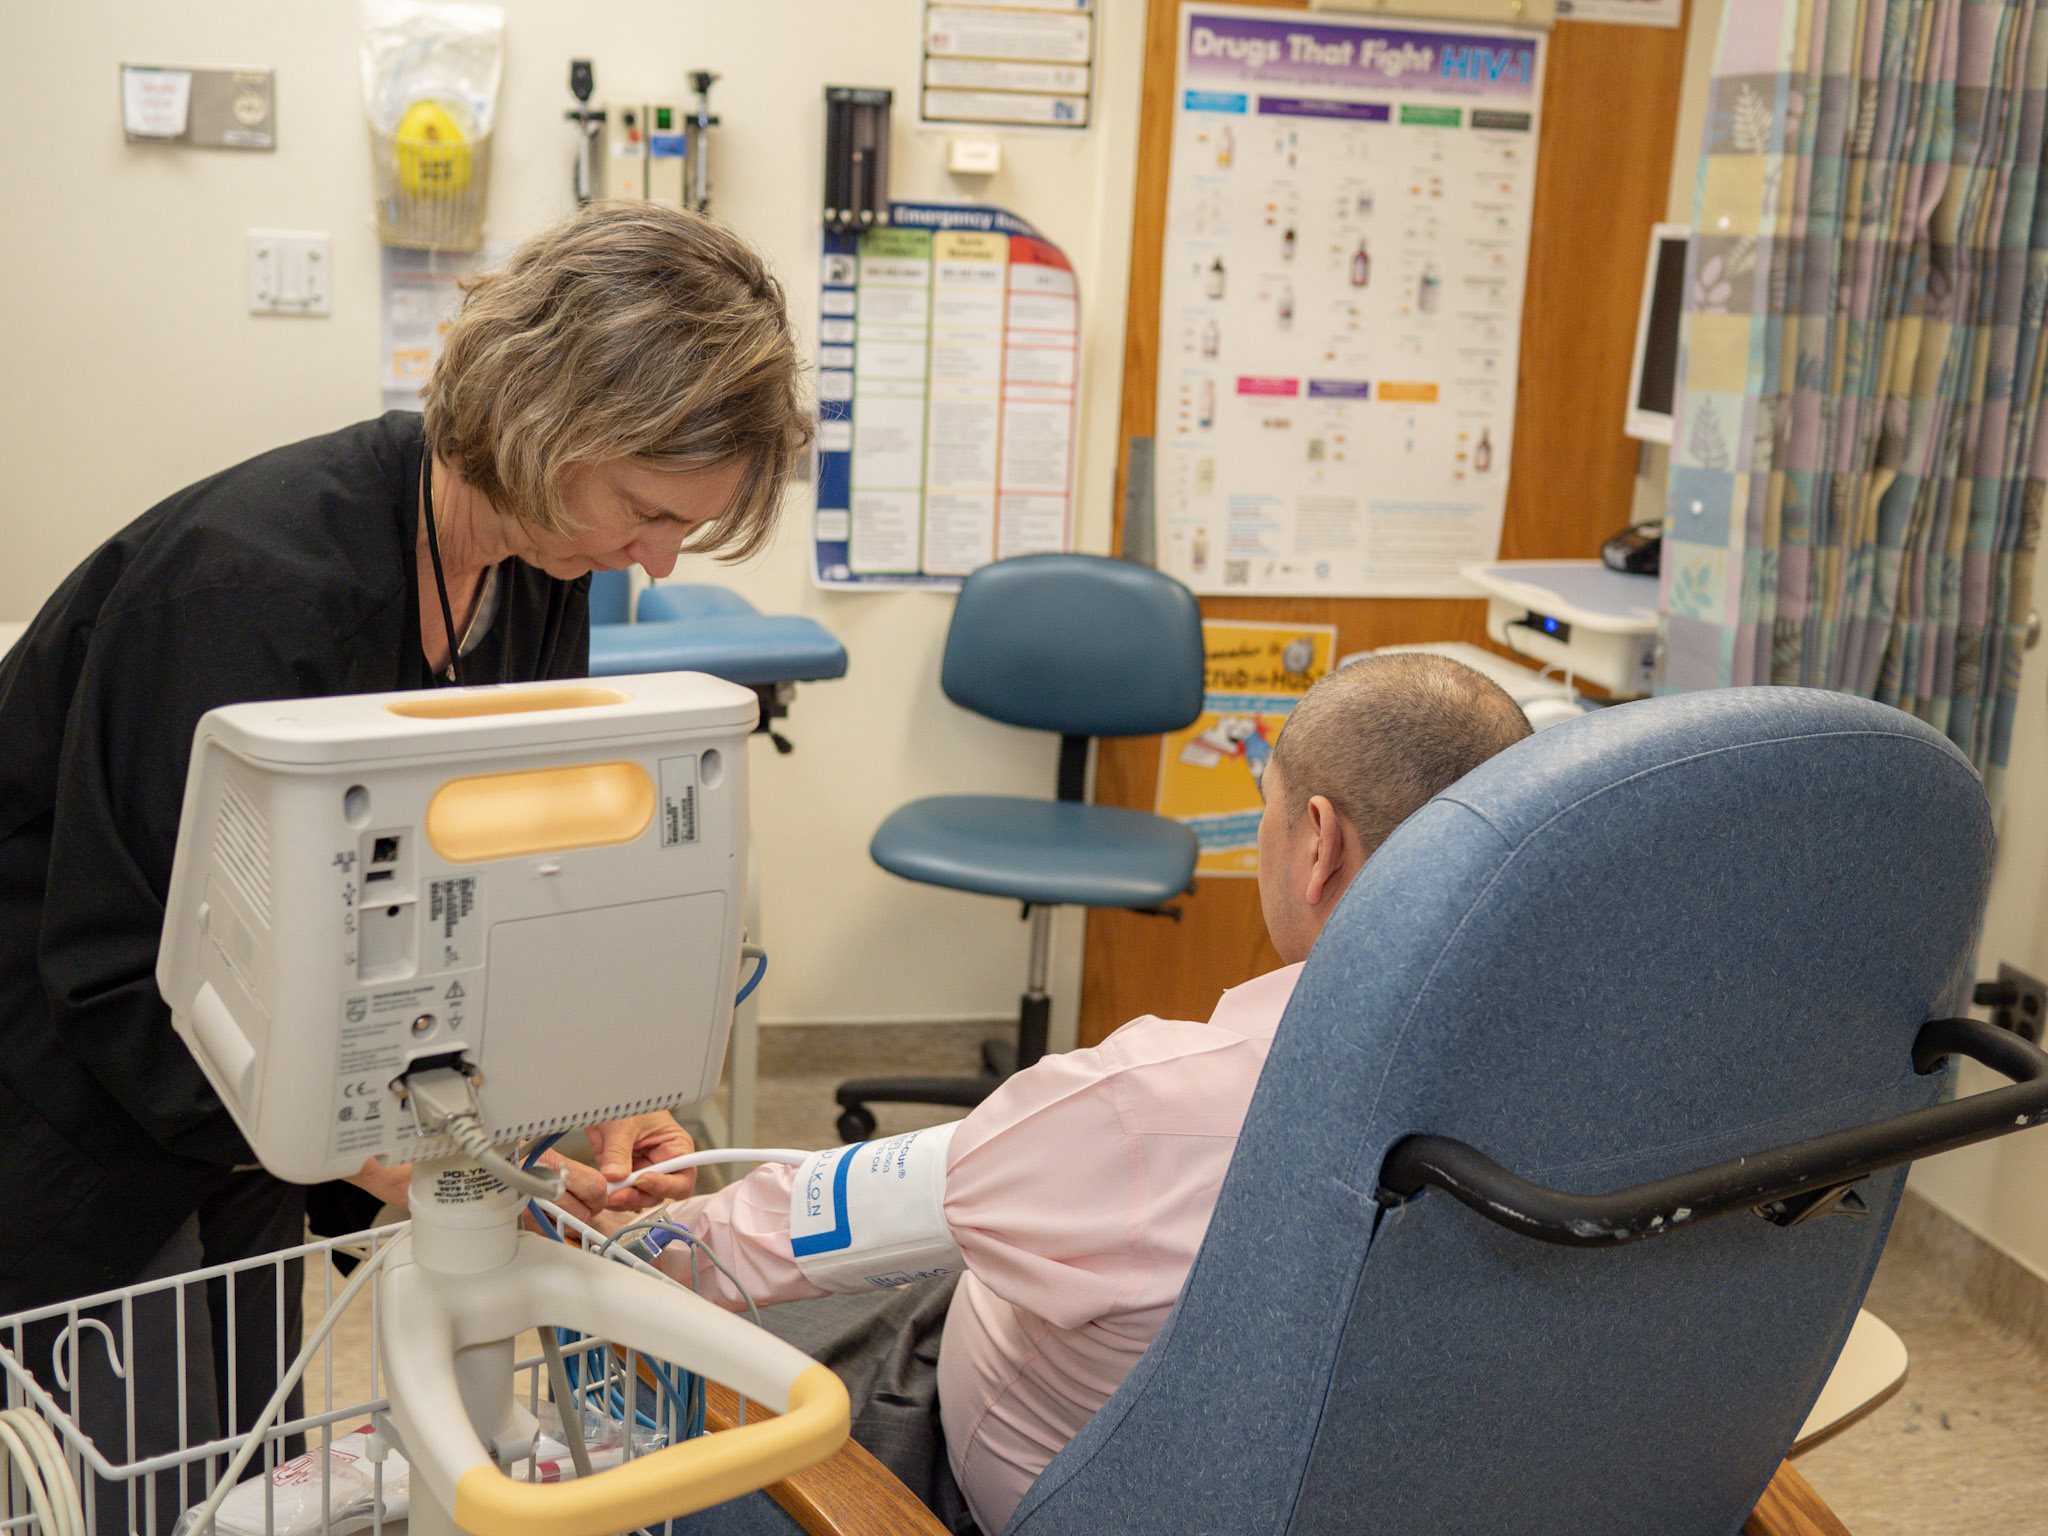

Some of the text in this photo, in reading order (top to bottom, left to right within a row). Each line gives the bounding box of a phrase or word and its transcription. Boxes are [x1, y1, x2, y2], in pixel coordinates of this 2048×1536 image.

[1192, 27, 1532, 85] Drugs That Fight HIV-1
[893, 206, 993, 231] Emergency
[871, 1156, 880, 1173] CM
